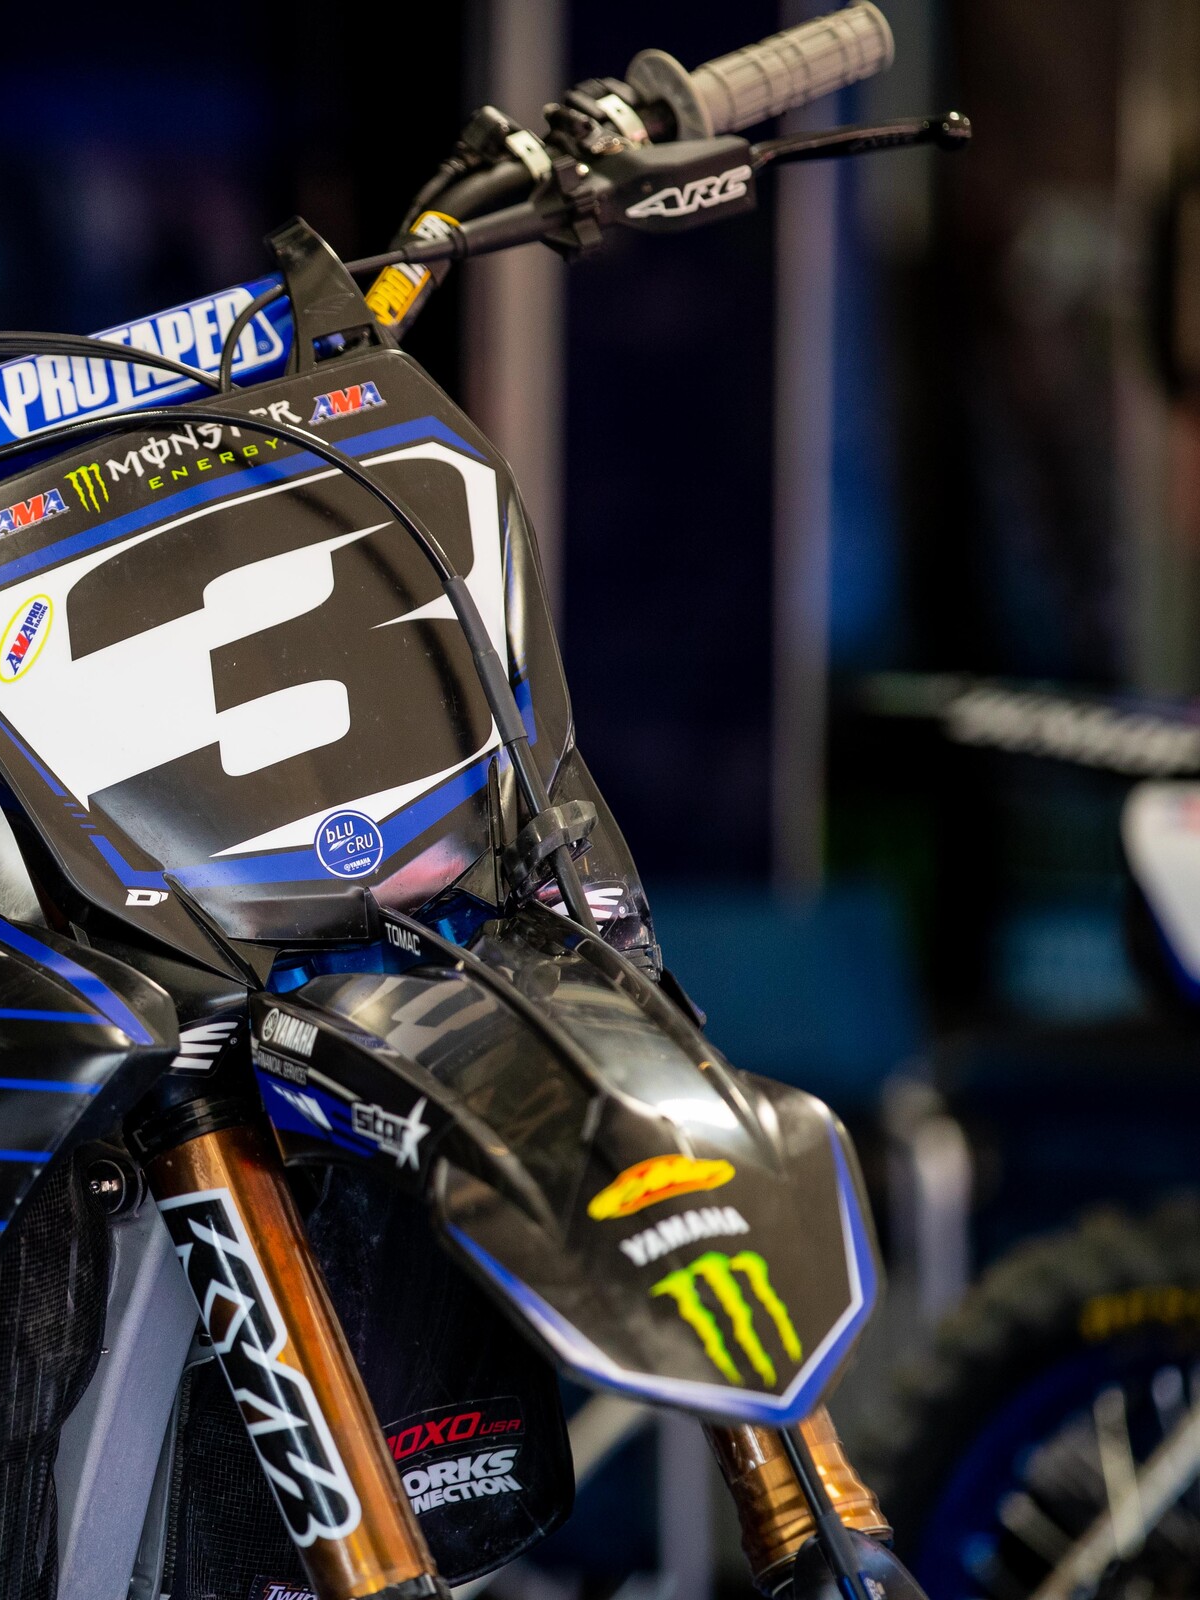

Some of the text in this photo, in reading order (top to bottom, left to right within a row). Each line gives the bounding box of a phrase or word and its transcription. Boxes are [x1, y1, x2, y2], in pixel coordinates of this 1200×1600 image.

[308, 381, 387, 426] AMA
[148, 437, 280, 491] ENERGY
[6, 602, 43, 675] AMA PRO
[33, 605, 48, 629] RACING
[66, 456, 496, 862] 3
[384, 921, 421, 957] TOMAC
[273, 1012, 319, 1058] YAMAHA
[619, 1206, 750, 1257] YAMAHA
[479, 1419, 522, 1435] USA
[402, 1449, 518, 1497] ORKS
[410, 1475, 523, 1516] NECTION
